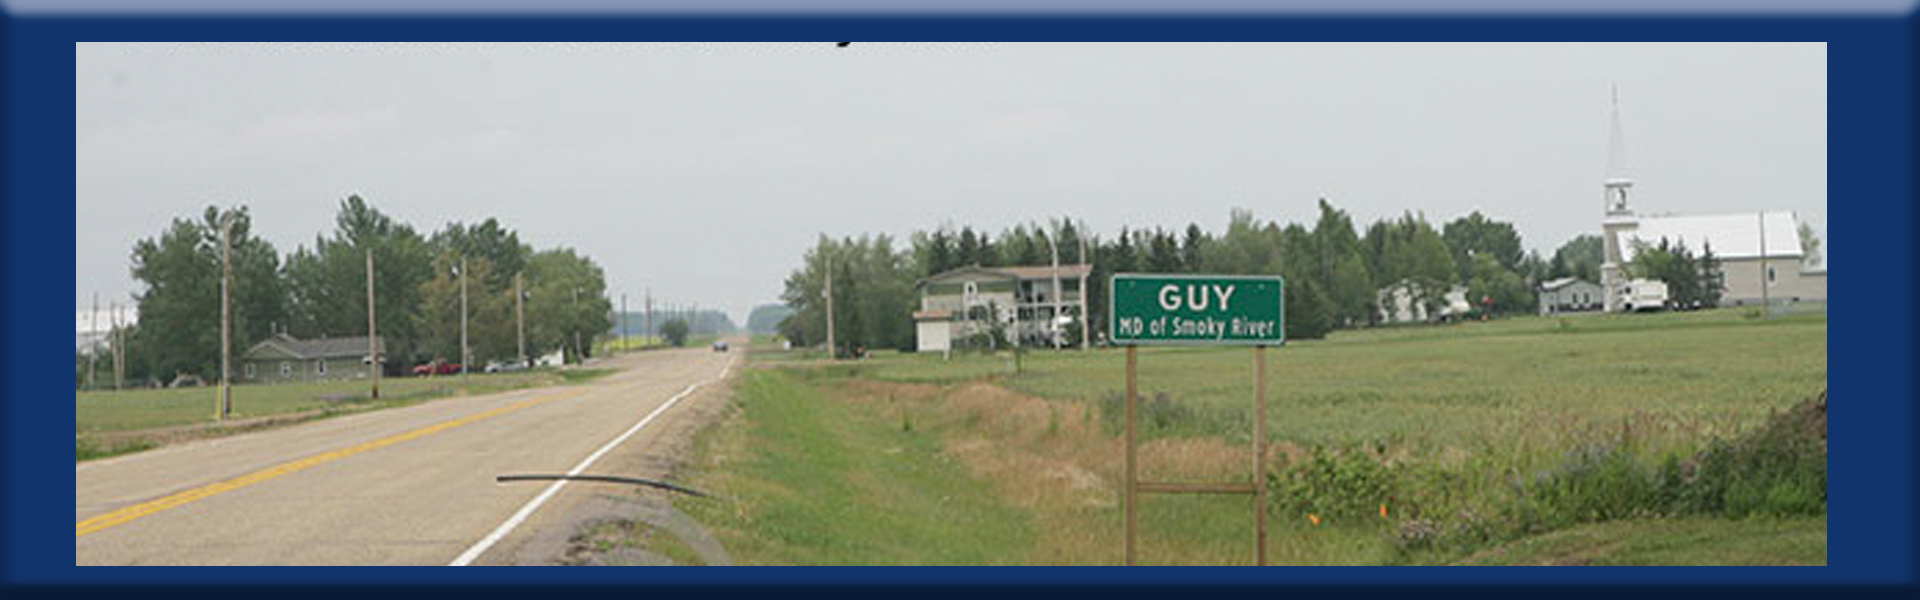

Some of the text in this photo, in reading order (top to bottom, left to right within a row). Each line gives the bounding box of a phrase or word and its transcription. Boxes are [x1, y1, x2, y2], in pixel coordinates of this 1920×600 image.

[1158, 284, 1235, 311] GUY
[1119, 317, 1275, 341] MD of Smoky River
